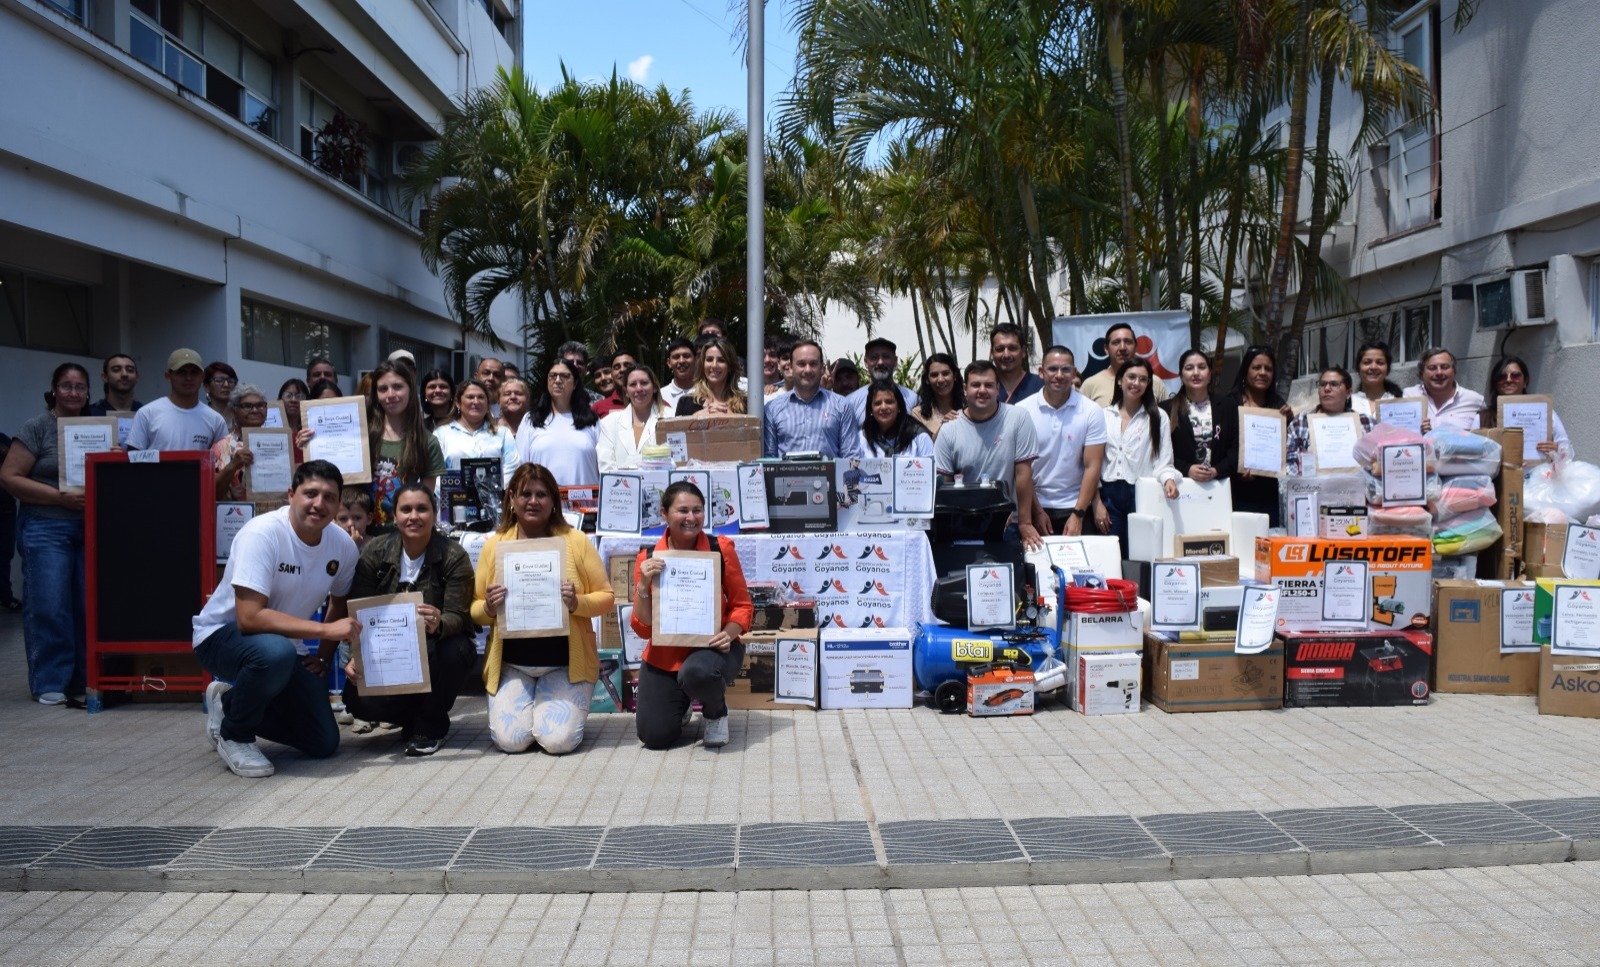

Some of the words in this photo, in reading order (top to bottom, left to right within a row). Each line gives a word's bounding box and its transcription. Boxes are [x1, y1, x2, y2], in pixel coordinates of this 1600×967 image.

[1185, 547, 1208, 555] Morelli
[771, 566, 807, 574] Goyanos
[814, 565, 850, 574] Goyanos
[855, 565, 891, 574] Goyanos
[1277, 580, 1317, 588] SIERRA
[815, 599, 850, 608] Goyanos
[857, 600, 892, 609] Goyanos
[1081, 616, 1124, 624] BELARRA
[1003, 648, 1019, 657] 50
[1295, 642, 1356, 661] OMAHA
[1551, 674, 1600, 693] Asko
